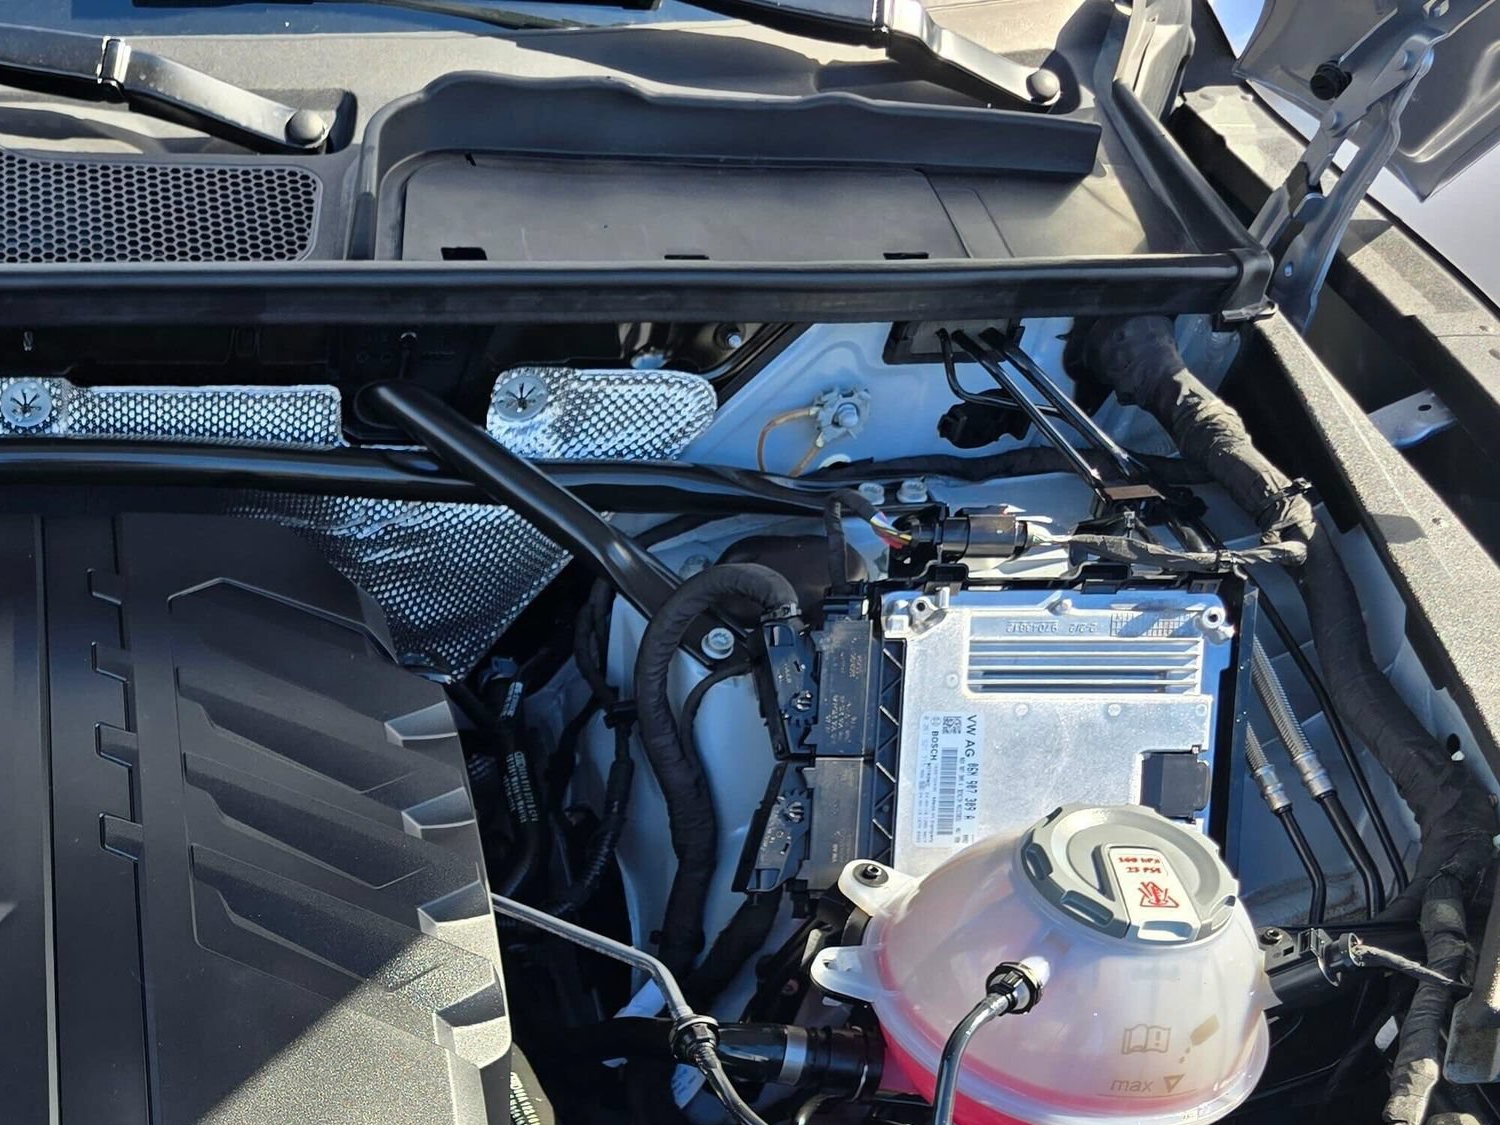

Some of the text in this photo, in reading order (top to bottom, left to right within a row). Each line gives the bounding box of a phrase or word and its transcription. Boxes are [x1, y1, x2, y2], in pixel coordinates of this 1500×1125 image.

[965, 714, 977, 736] VW
[930, 731, 939, 761] BOSCH
[964, 739, 976, 758] AG
[1110, 1080, 1155, 1093] max
